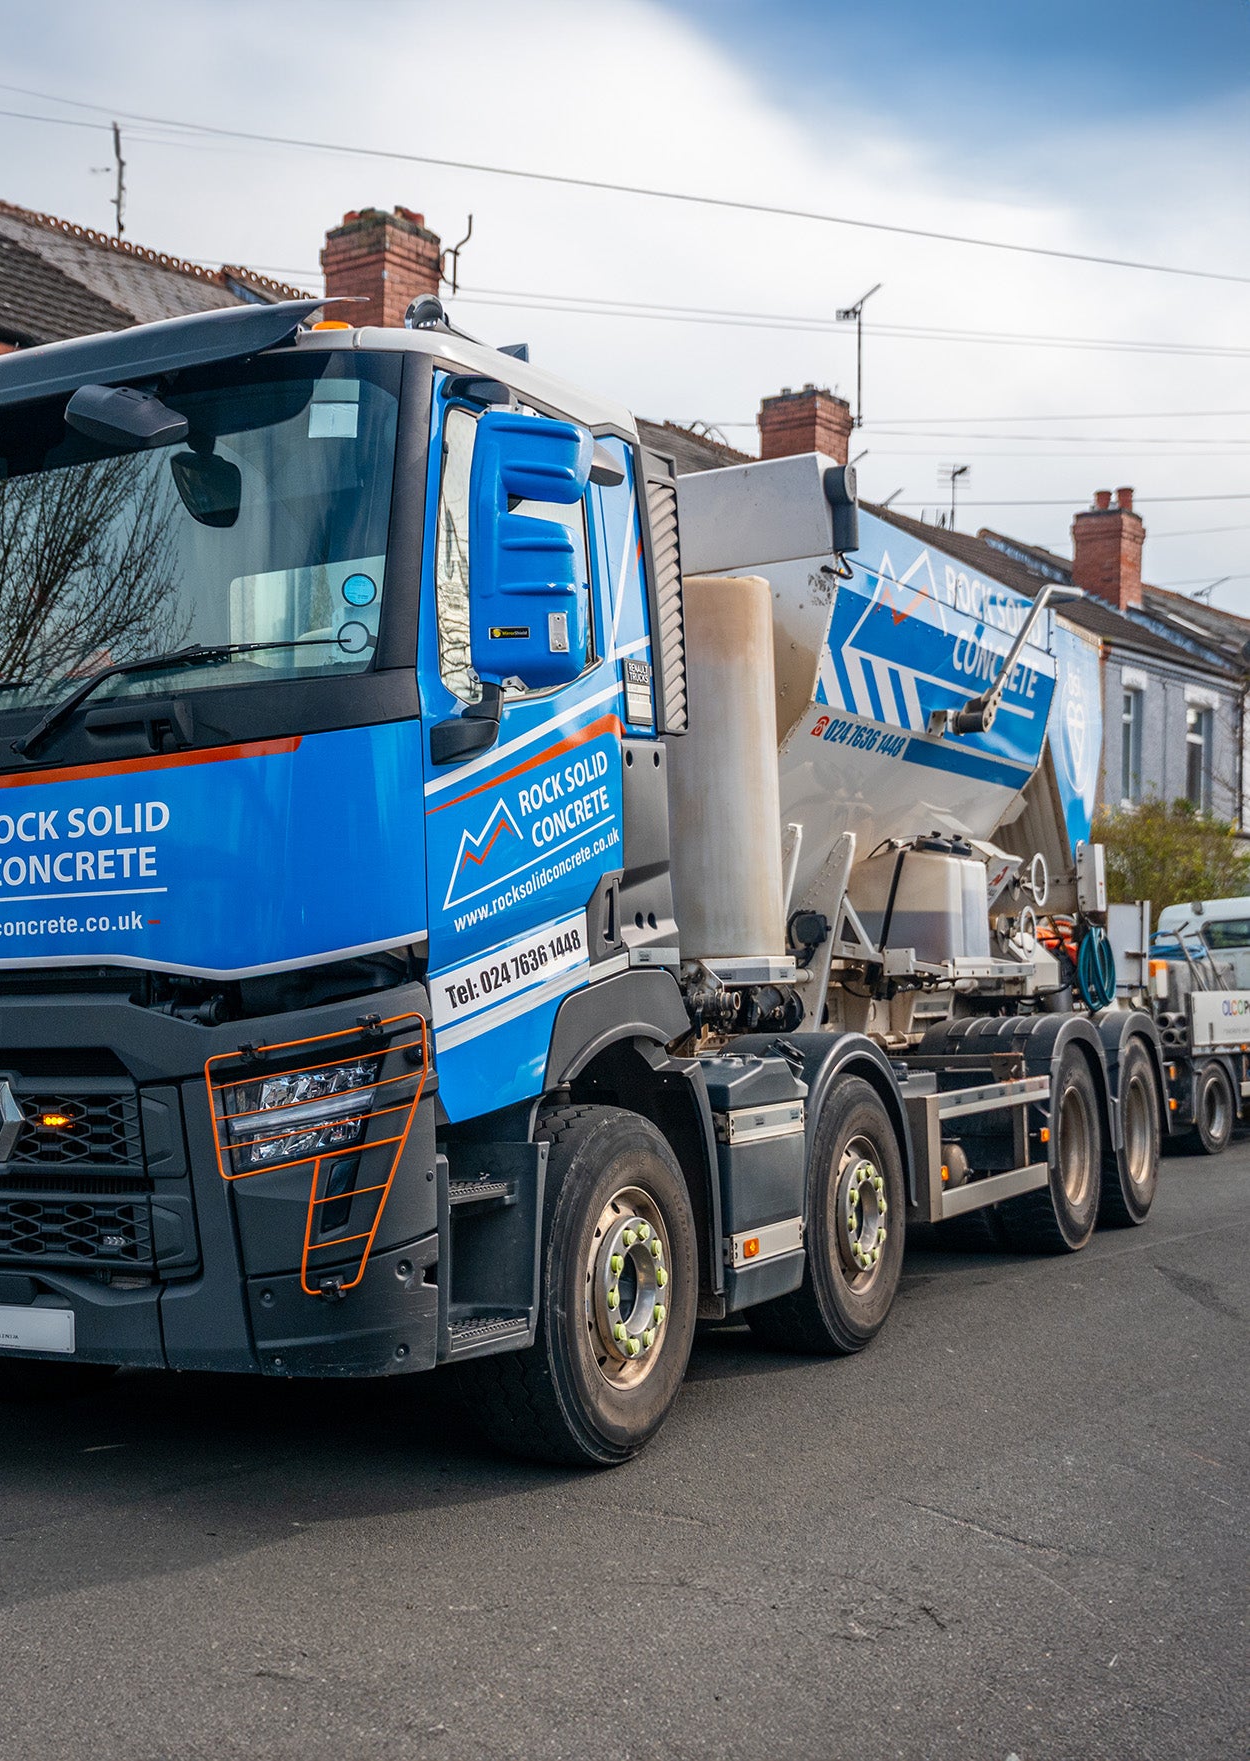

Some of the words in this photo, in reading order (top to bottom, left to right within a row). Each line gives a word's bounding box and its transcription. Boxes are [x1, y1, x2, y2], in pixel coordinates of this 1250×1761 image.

[945, 565, 993, 625] ROCK
[953, 630, 1039, 699] CONCETE
[823, 719, 854, 744] 024
[845, 724, 882, 751] 7636
[875, 733, 907, 758] 1448
[518, 772, 565, 816] ROCK
[565, 751, 608, 793] SOLID
[67, 801, 170, 838] SOLID
[531, 785, 610, 848] CONCRETE
[453, 826, 620, 933] www.rocksolidconcrete.co.uk
[444, 977, 480, 1009] Tel:
[479, 961, 512, 994] 024
[510, 944, 548, 980] 7636
[548, 929, 581, 961] 1448
